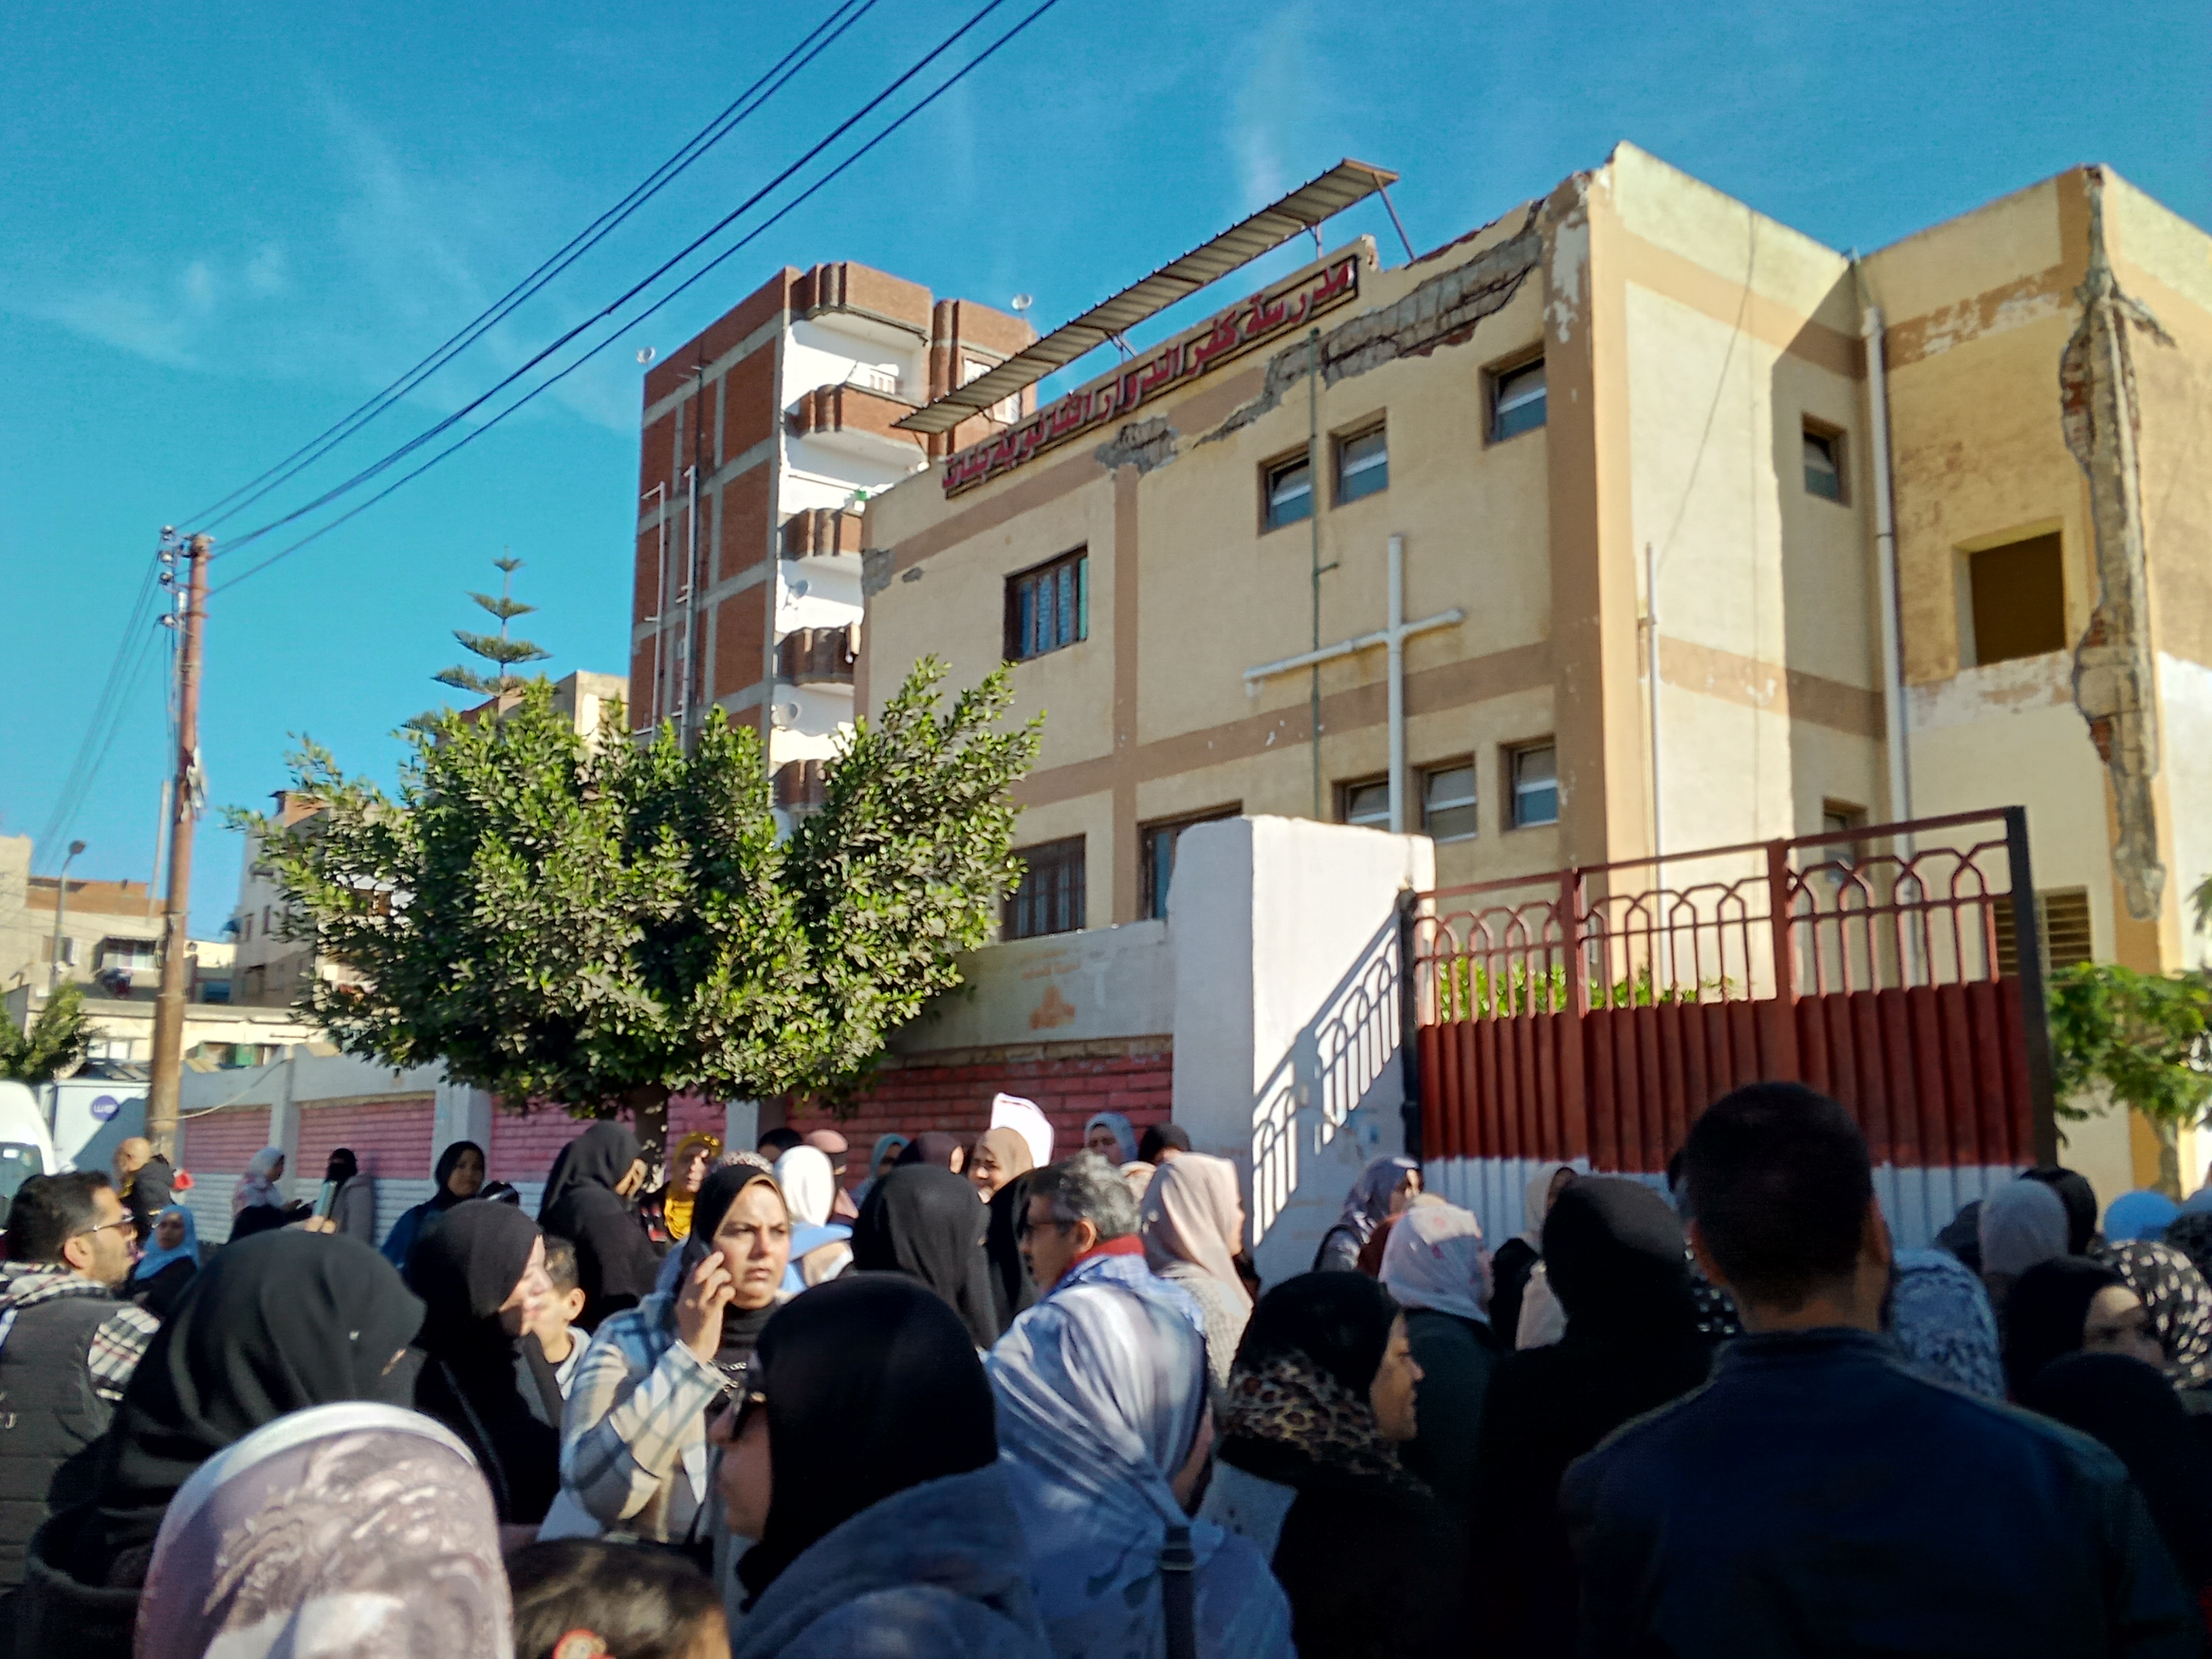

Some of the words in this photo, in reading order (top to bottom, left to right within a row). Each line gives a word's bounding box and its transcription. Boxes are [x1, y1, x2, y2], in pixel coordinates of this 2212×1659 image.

[1246, 262, 1351, 335] مدرسة
[1186, 310, 1240, 376] كفر
[1094, 342, 1183, 422] الدوار
[994, 392, 1094, 468] الثانوية
[943, 447, 991, 489] بنات
